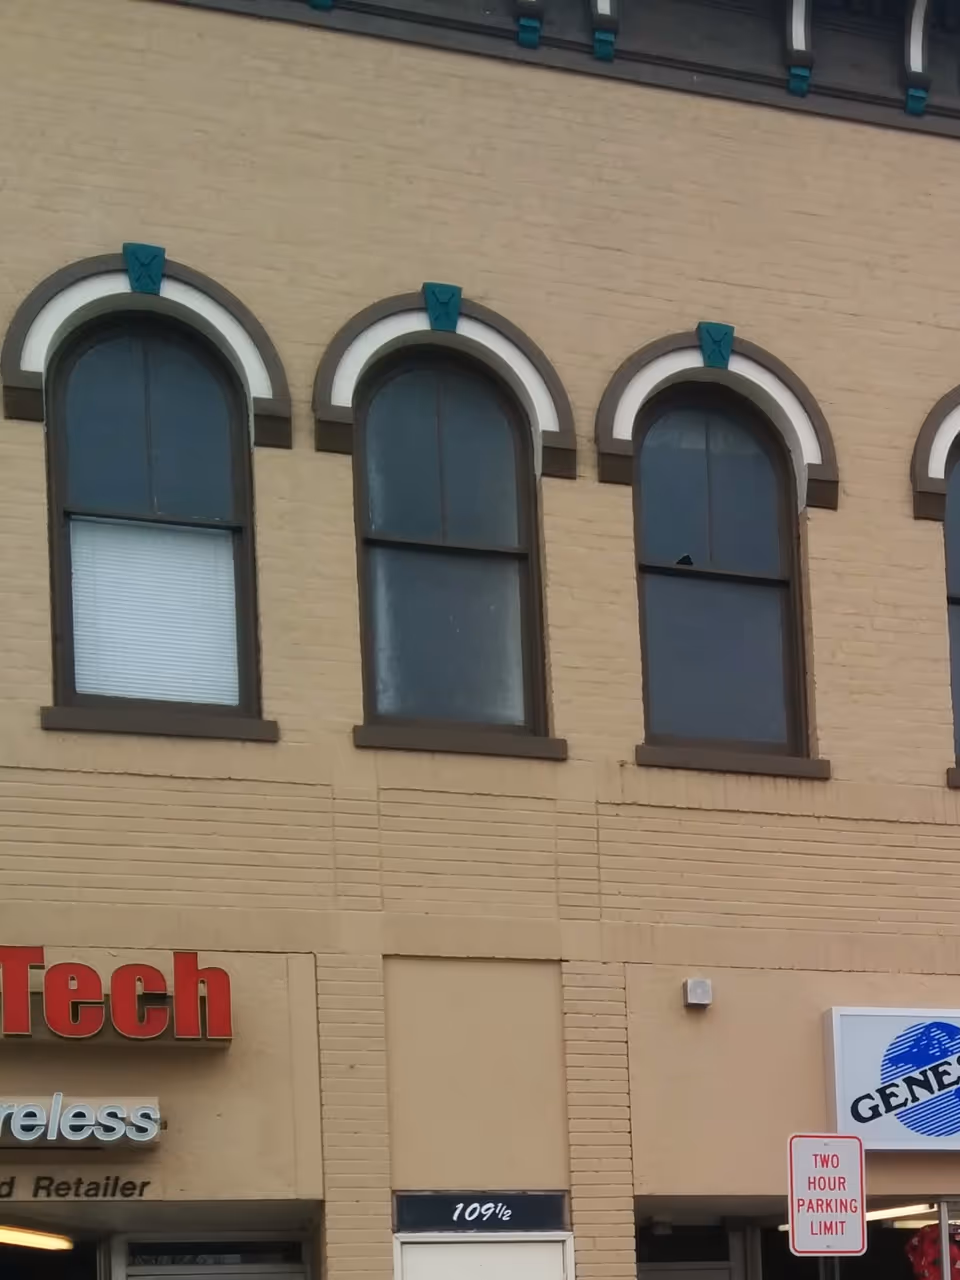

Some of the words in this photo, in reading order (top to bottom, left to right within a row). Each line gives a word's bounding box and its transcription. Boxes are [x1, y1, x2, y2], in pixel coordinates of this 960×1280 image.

[0, 946, 233, 1039] Tech
[812, 1154, 839, 1168] TWO
[32, 1176, 151, 1198] Retailer
[808, 1176, 847, 1191] HOUR
[797, 1198, 858, 1214] PARKING
[810, 1220, 846, 1235] LIMIT
